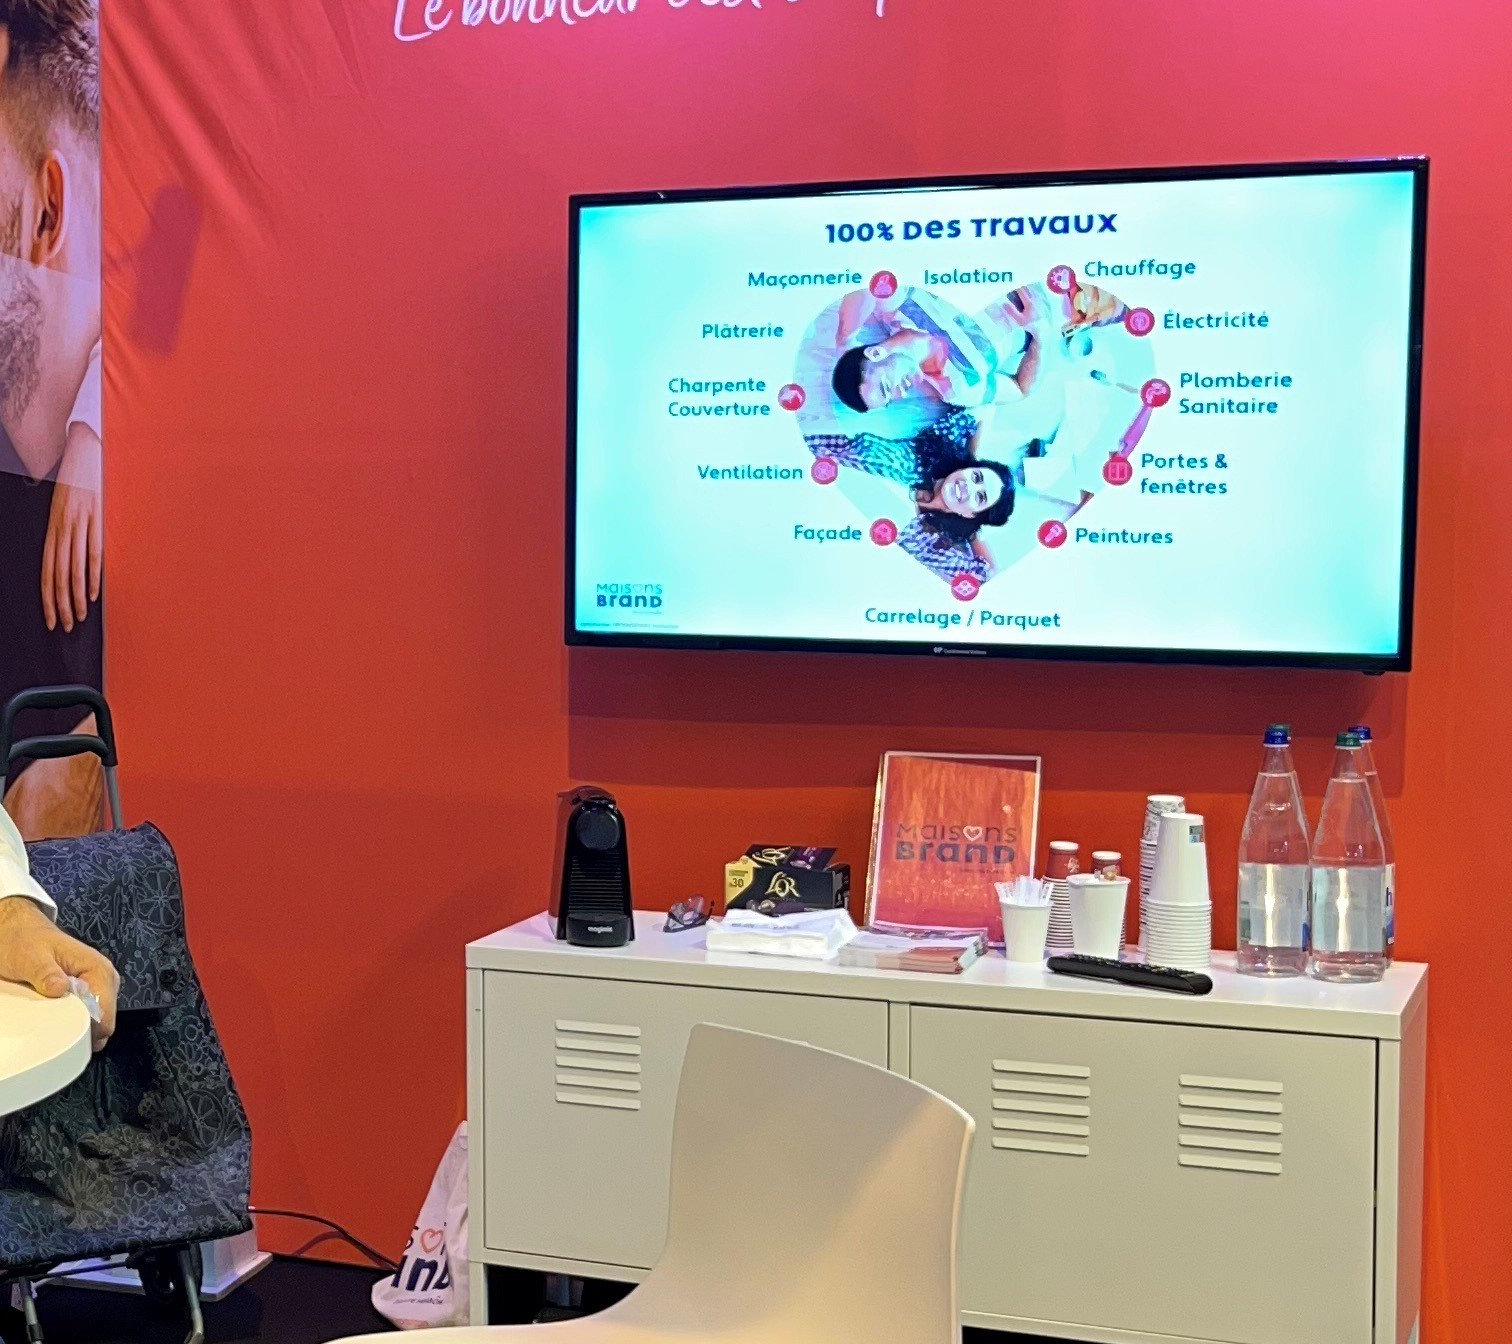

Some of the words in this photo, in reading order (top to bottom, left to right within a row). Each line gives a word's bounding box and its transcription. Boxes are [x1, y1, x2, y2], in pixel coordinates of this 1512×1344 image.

[825, 221, 895, 244] 100%
[747, 268, 863, 291] Maçonnerie
[924, 266, 1014, 286] Isolation
[1083, 259, 1197, 281] Chauffage
[1163, 308, 1270, 330] Électricité
[701, 322, 785, 340] Plâtrerie
[668, 376, 767, 397] Charpente
[1180, 371, 1293, 390] Plomberie
[668, 401, 771, 418] Couverture
[1179, 397, 1279, 415] Sanitaire
[1140, 453, 1209, 471] Portes
[1215, 453, 1229, 471] &
[696, 463, 804, 482] Ventilation
[1140, 478, 1229, 496] fenêtres
[793, 524, 863, 545] Façade
[1075, 527, 1174, 545] Peintures
[864, 607, 962, 629] Carrelage
[979, 609, 1062, 632] Parquet
